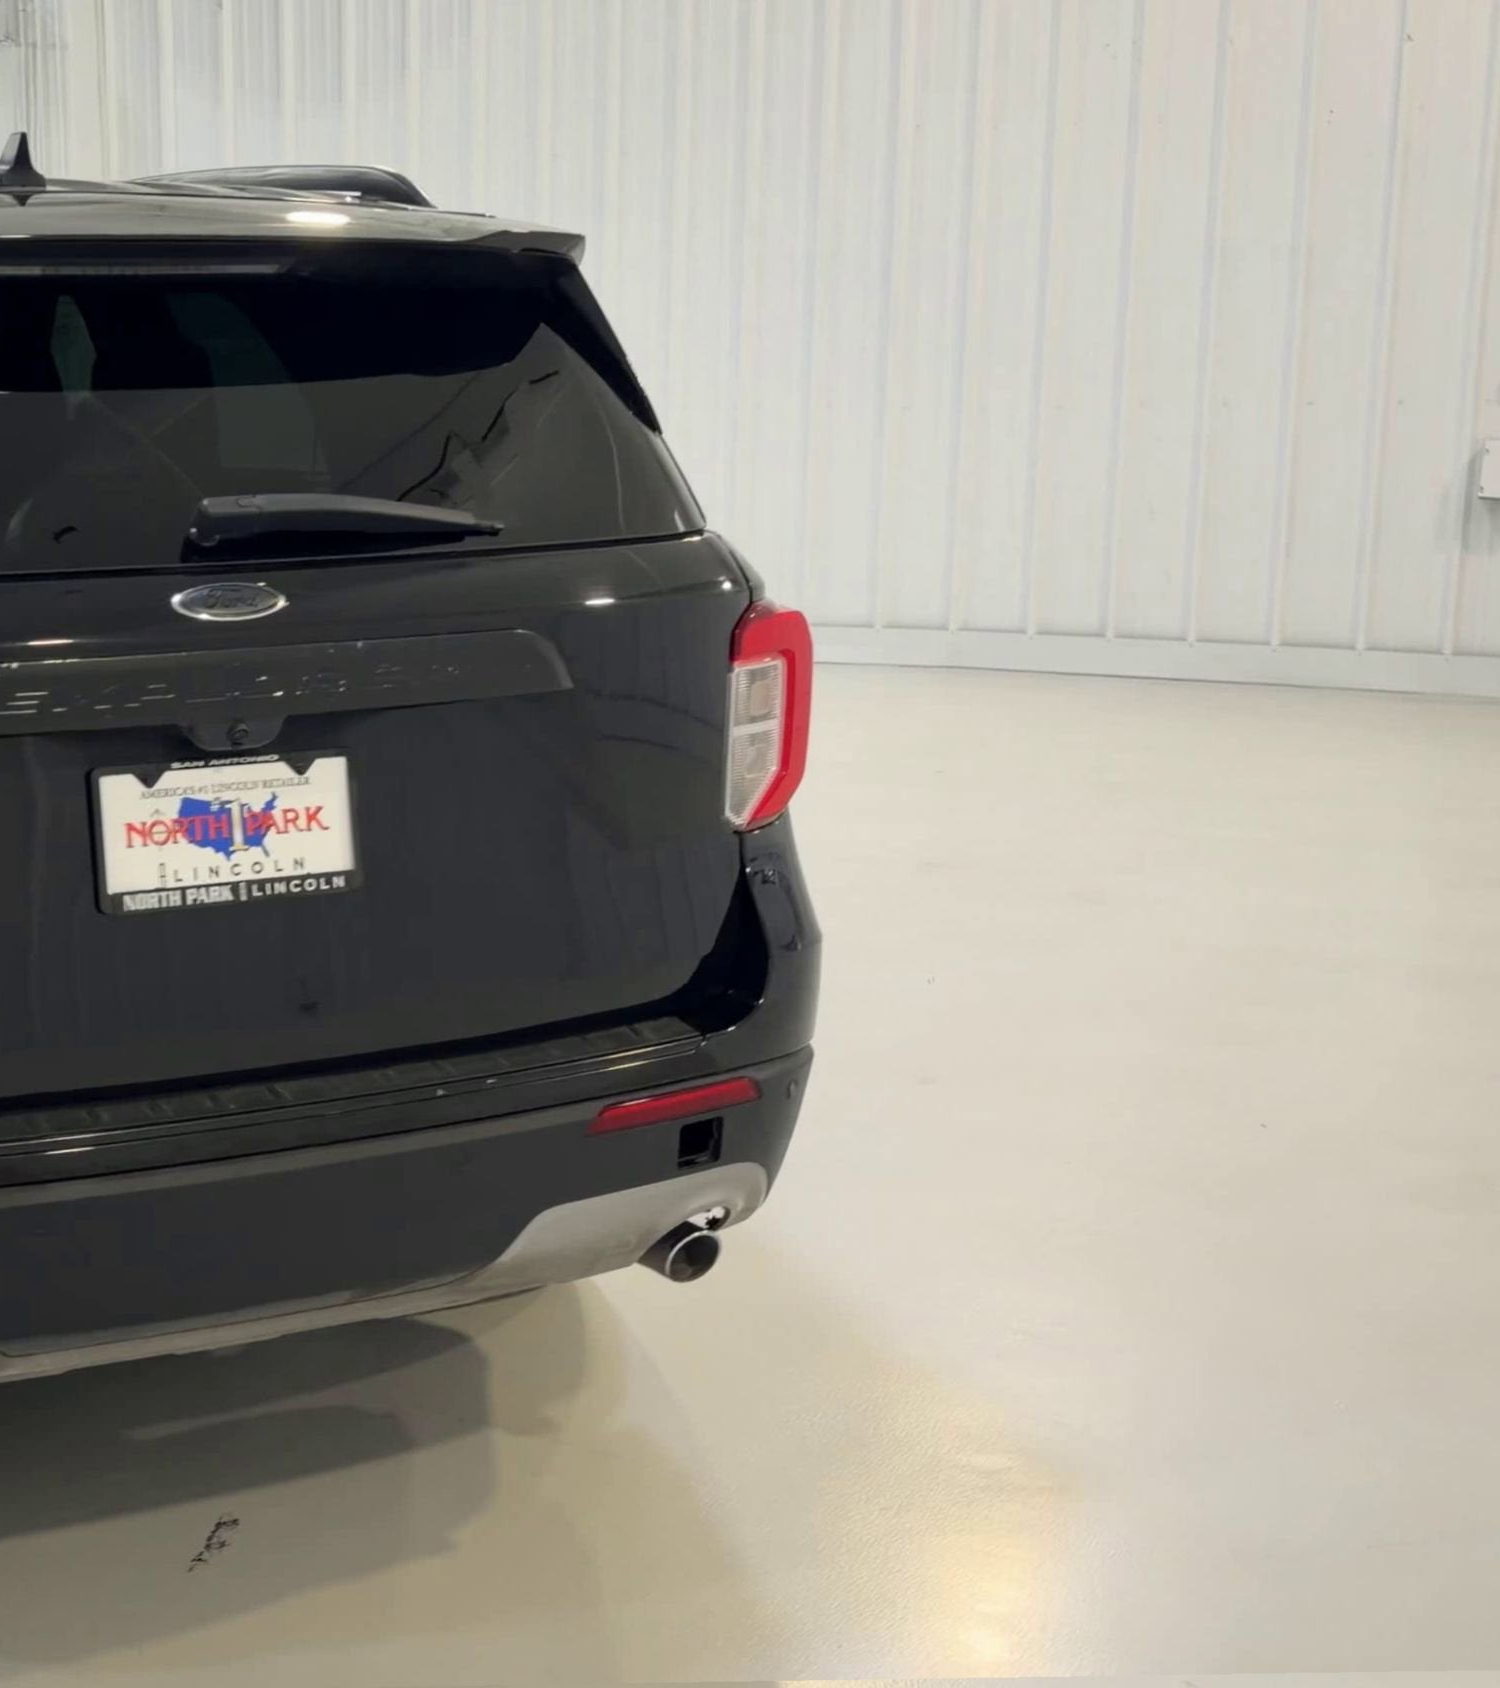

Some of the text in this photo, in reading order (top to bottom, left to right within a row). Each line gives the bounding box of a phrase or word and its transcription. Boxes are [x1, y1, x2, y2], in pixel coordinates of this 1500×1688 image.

[170, 754, 279, 769] SAN ANTONIO
[124, 814, 230, 848] NORTH
[246, 805, 330, 835] PARK
[173, 857, 306, 883] LINCOLN
[122, 875, 346, 912] NORTH PARK LINCOLN
